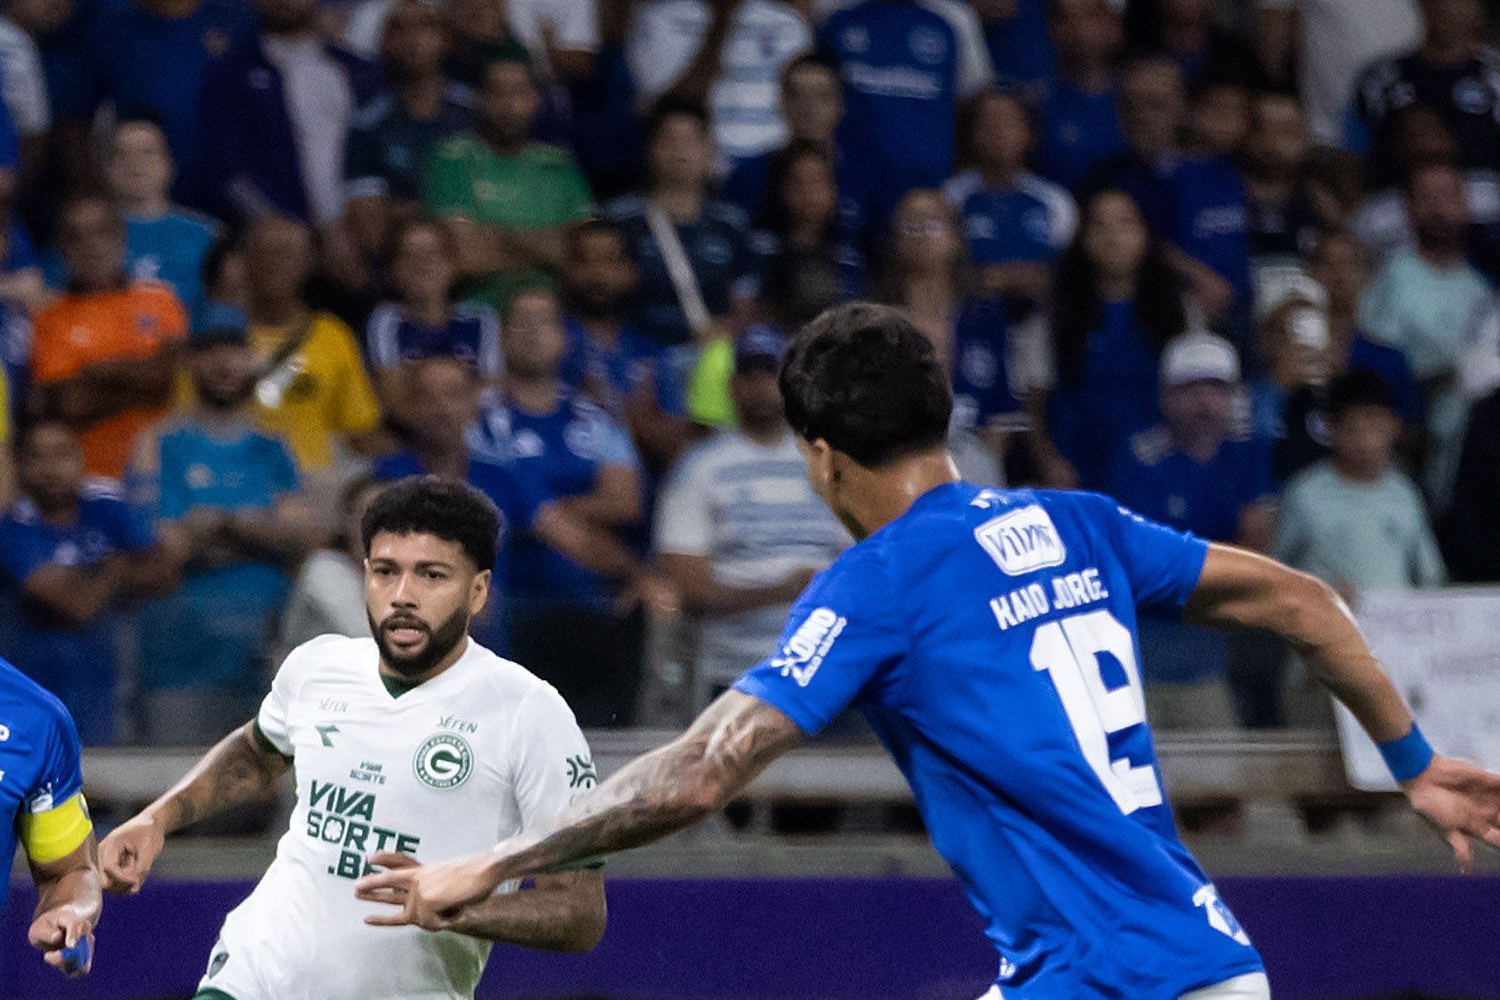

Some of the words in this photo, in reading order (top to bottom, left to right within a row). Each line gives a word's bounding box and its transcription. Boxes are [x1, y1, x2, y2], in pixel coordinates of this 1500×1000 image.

[989, 583, 1049, 631] KAIO
[1029, 607, 1164, 816] 19
[310, 779, 376, 821] VIVA
[307, 810, 421, 853] SORTE
